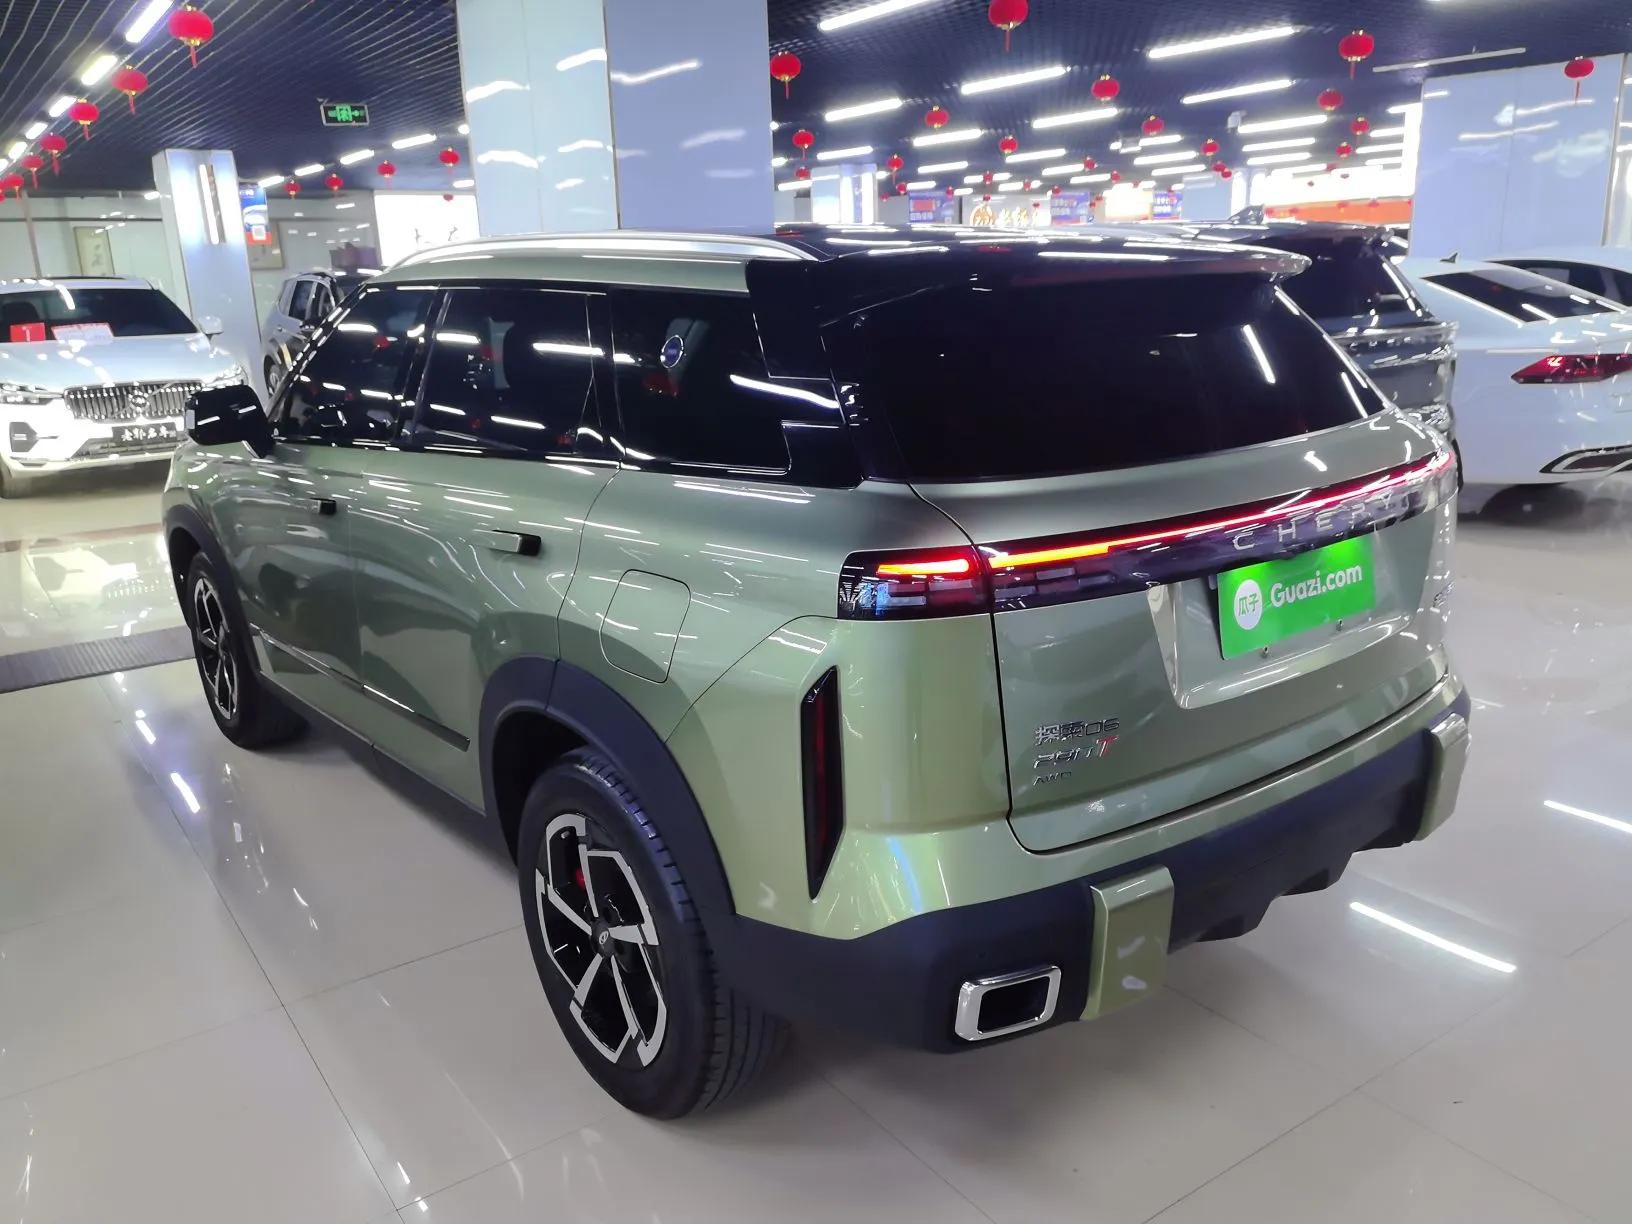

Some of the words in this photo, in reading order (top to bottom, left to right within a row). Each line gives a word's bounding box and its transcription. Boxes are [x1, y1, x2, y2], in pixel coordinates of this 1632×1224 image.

[1232, 489, 1394, 551] CHERY
[1271, 565, 1363, 608] Guazi.com
[1238, 592, 1260, 617] 瓜子
[1034, 718, 1120, 746] 探索06
